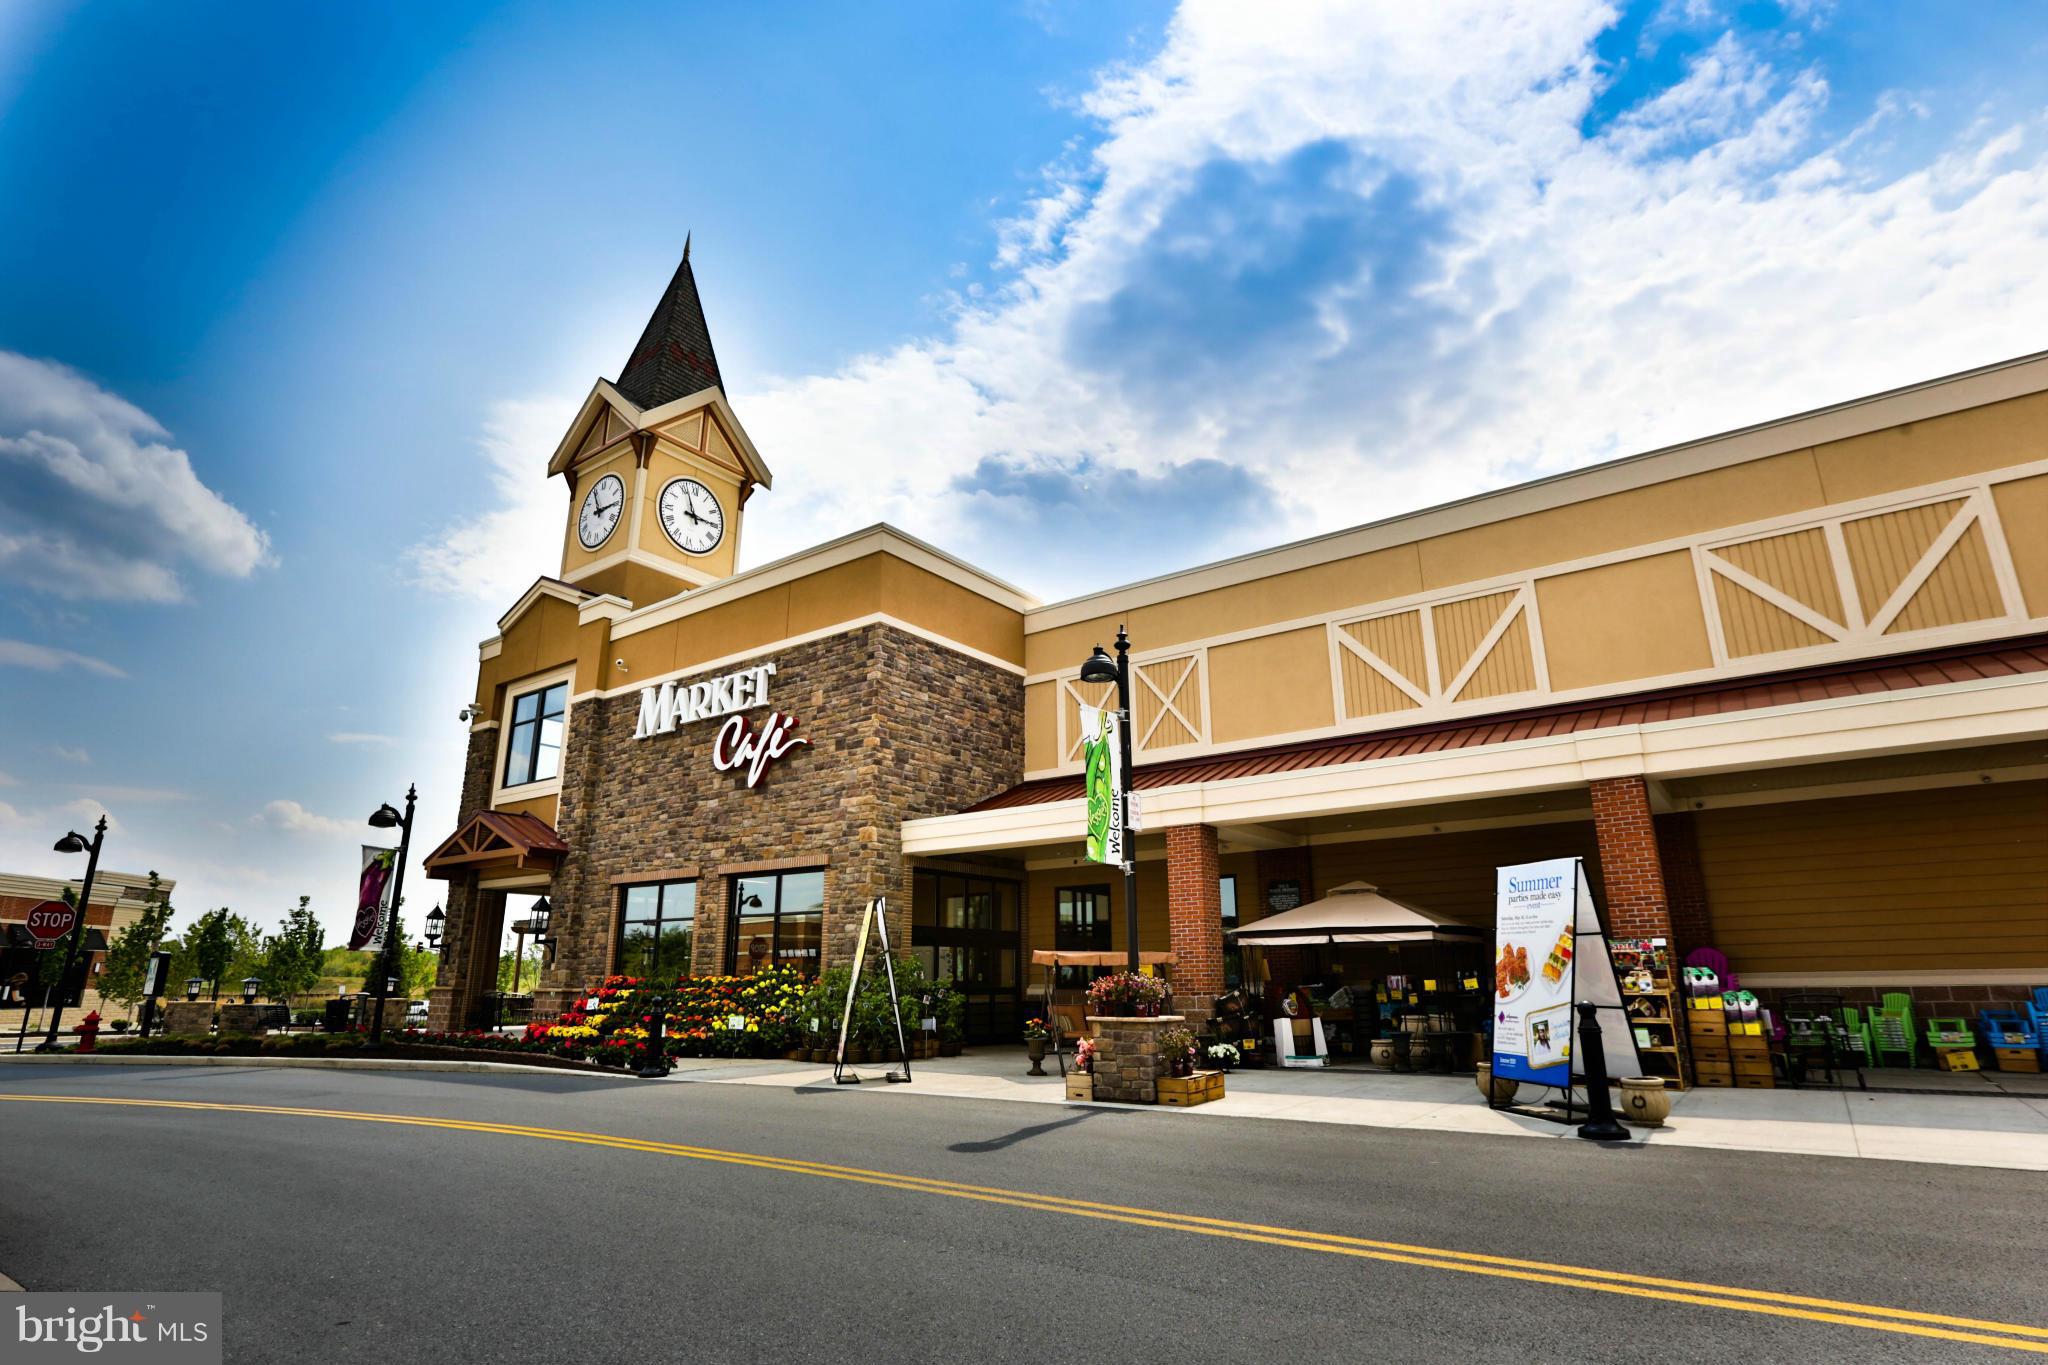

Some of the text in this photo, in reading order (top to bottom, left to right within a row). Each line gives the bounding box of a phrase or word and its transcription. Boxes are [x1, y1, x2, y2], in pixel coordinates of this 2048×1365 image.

[633, 662, 776, 739] MARKET
[1109, 788, 1120, 853] Welcome
[1509, 876, 1562, 893] Summer
[1530, 890, 1547, 901] made
[1547, 891, 1561, 902] easy
[30, 912, 73, 928] STOP
[373, 900, 388, 944] Welcome
